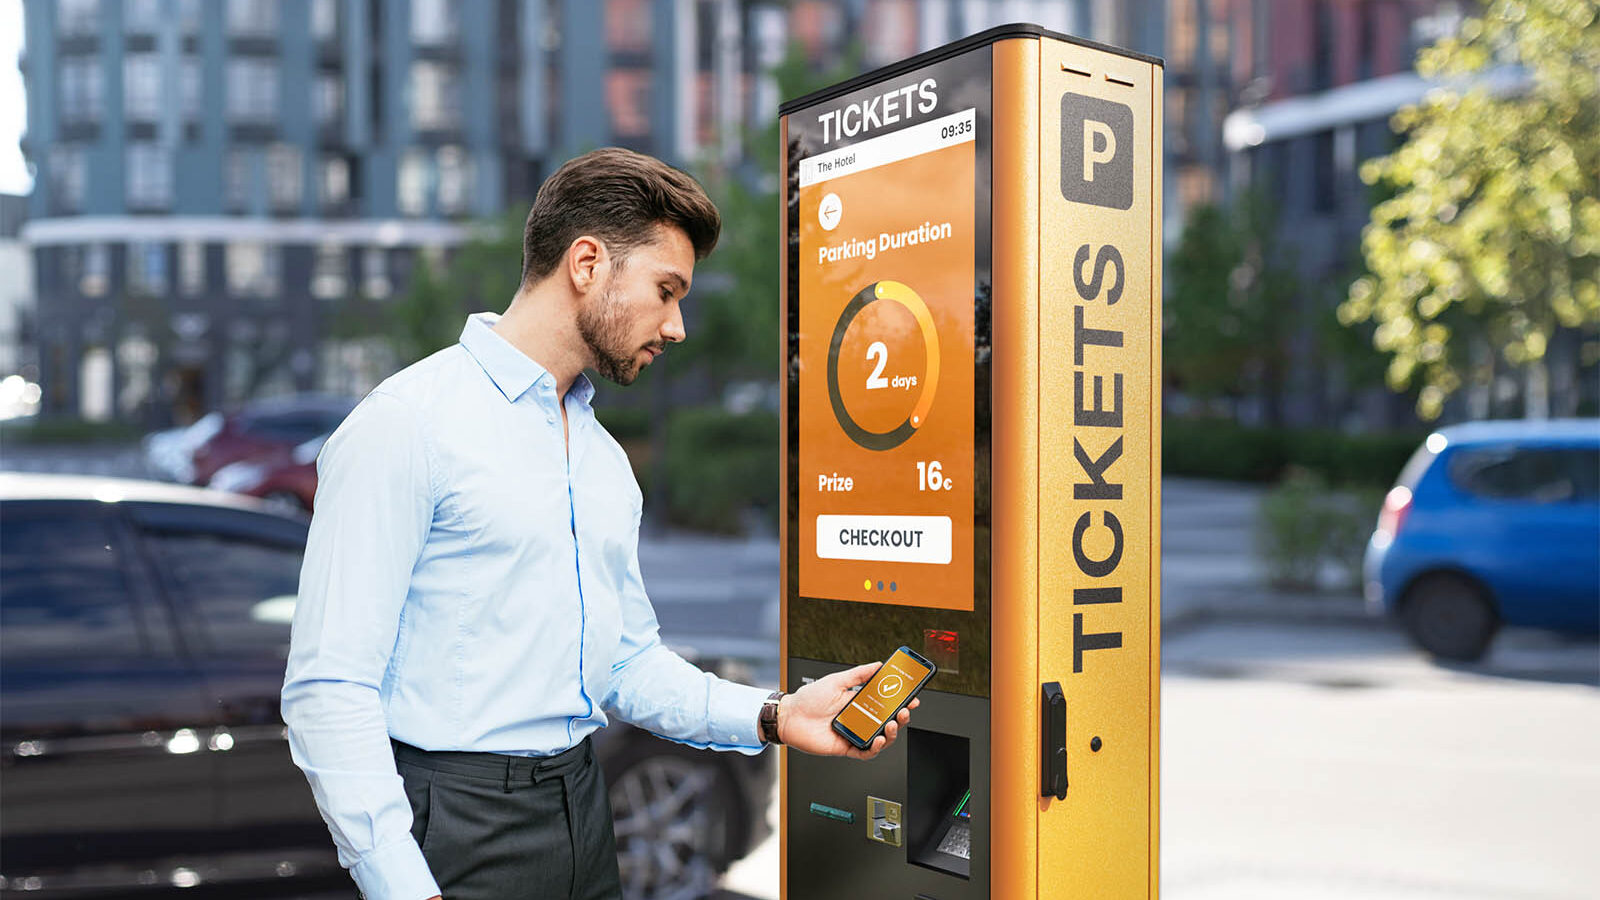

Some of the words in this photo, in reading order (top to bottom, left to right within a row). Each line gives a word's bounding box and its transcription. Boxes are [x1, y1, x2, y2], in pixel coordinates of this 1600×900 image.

[818, 78, 938, 144] TICKETS
[941, 120, 972, 139] 09:35
[818, 162, 832, 173] The
[835, 153, 856, 169] Hotel
[1083, 118, 1116, 182] P
[818, 236, 876, 264] Parking
[879, 221, 952, 252] Duration
[866, 341, 889, 389] 2
[891, 374, 918, 390] days
[1072, 243, 1125, 673] TICKETS
[818, 472, 854, 492] Prize
[839, 528, 923, 548] CHECKOUT
